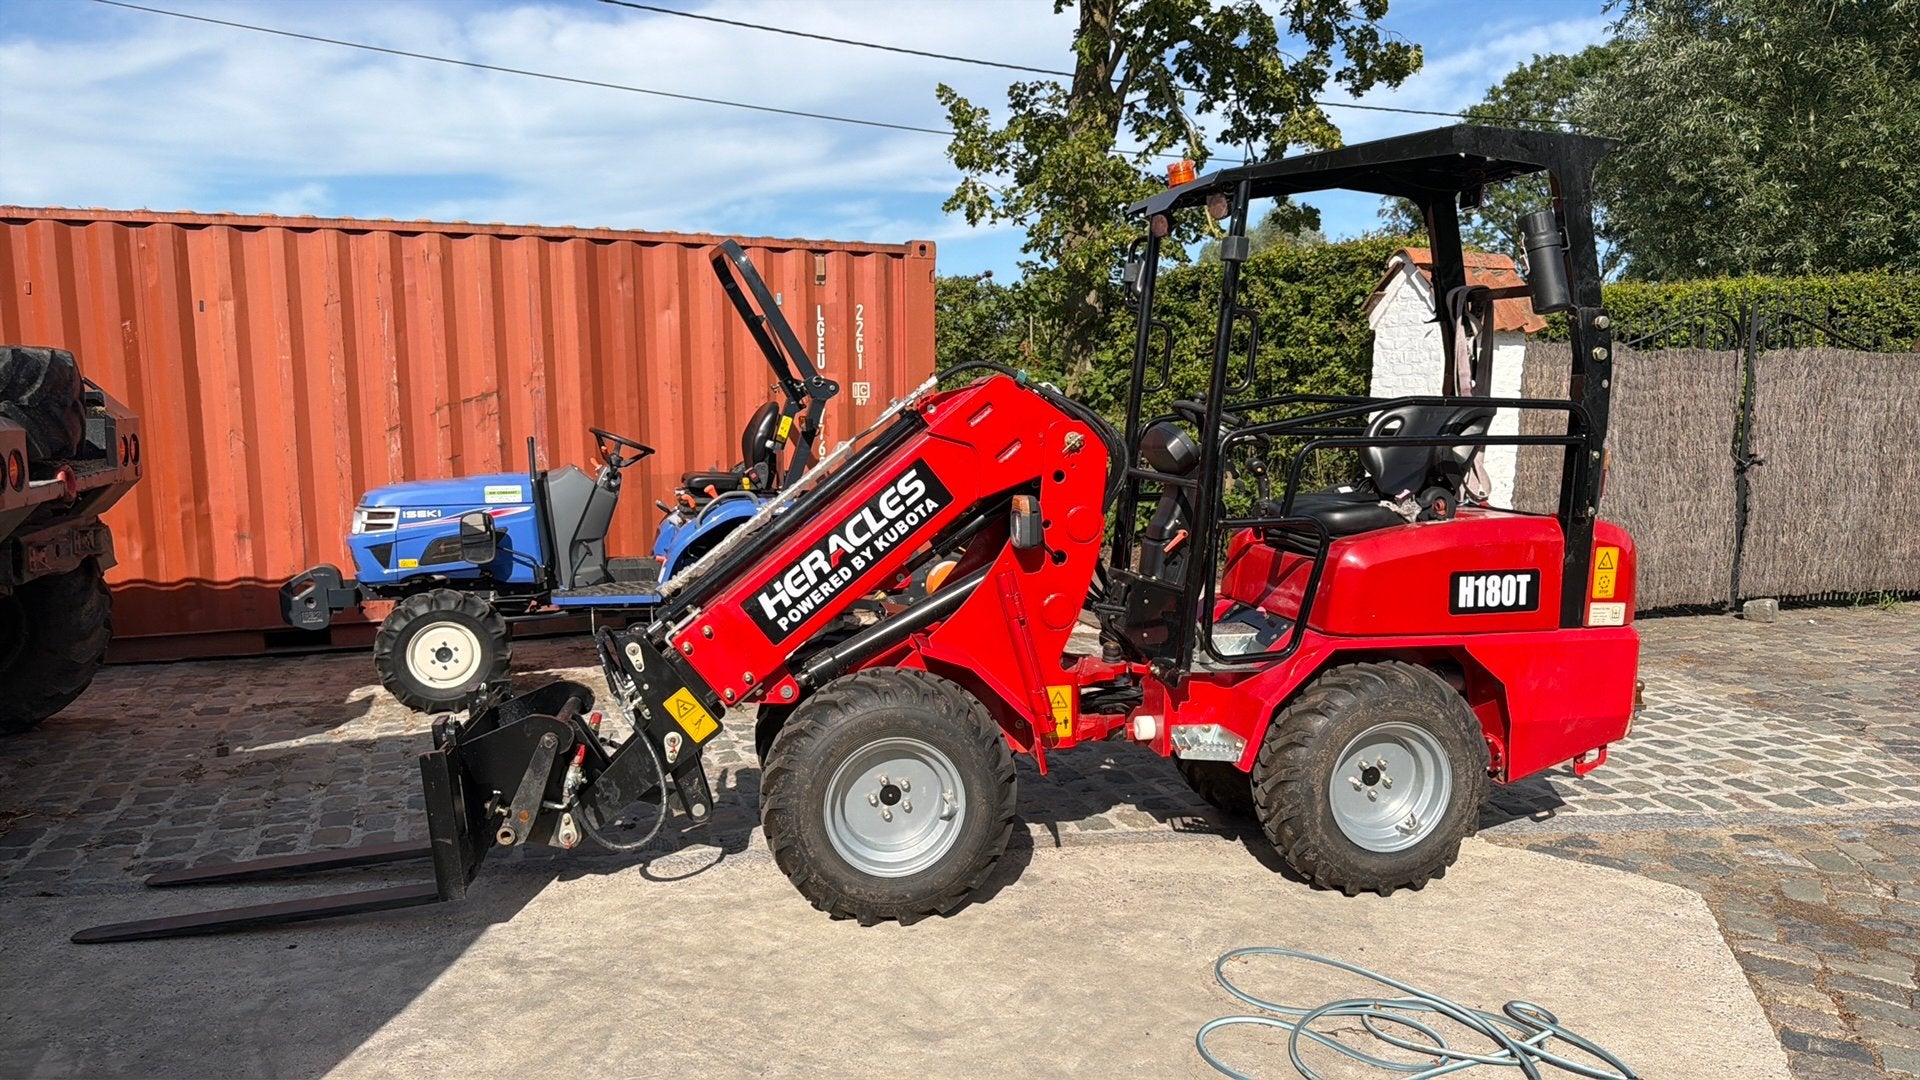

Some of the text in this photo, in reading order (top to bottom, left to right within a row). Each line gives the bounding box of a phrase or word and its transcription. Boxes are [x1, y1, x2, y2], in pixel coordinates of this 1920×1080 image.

[816, 304, 826, 370] LGEU
[855, 303, 864, 370] 22G1
[402, 509, 442, 519] ISEKI
[757, 468, 926, 620] HERACLES
[776, 497, 939, 632] POWERED BY KUBOTA
[1458, 574, 1532, 608] H180T
